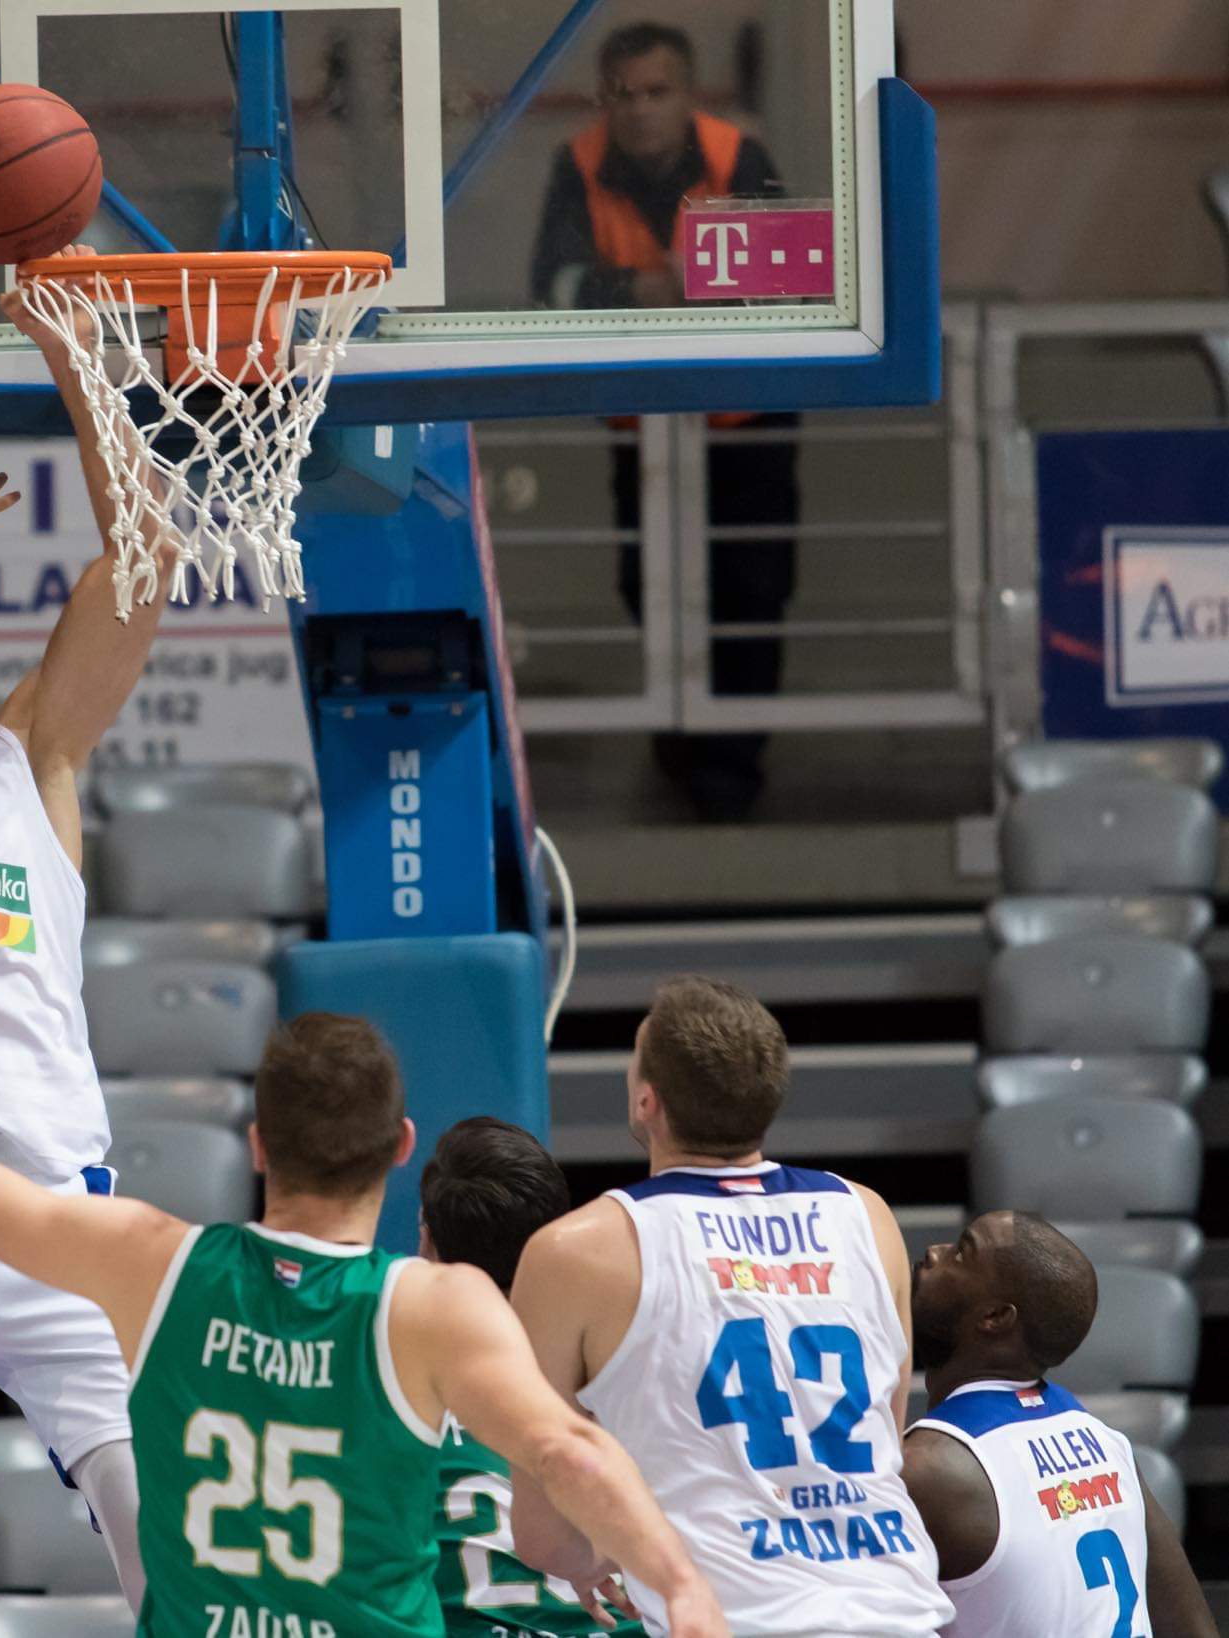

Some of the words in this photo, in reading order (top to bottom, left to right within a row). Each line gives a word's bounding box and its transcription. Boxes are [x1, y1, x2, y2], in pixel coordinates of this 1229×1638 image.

[388, 749, 423, 917] MONDO
[696, 1202, 828, 1256] FUNDIĆ
[707, 1256, 835, 1296] TOMMY
[201, 1317, 335, 1389] PETANI
[696, 1317, 876, 1473] 42
[1028, 1427, 1108, 1479] ALLEN
[183, 1407, 344, 1588] 25
[1037, 1471, 1124, 1521] TOMMY
[742, 1510, 916, 1562] ZADAR
[1076, 1528, 1148, 1638] 2
